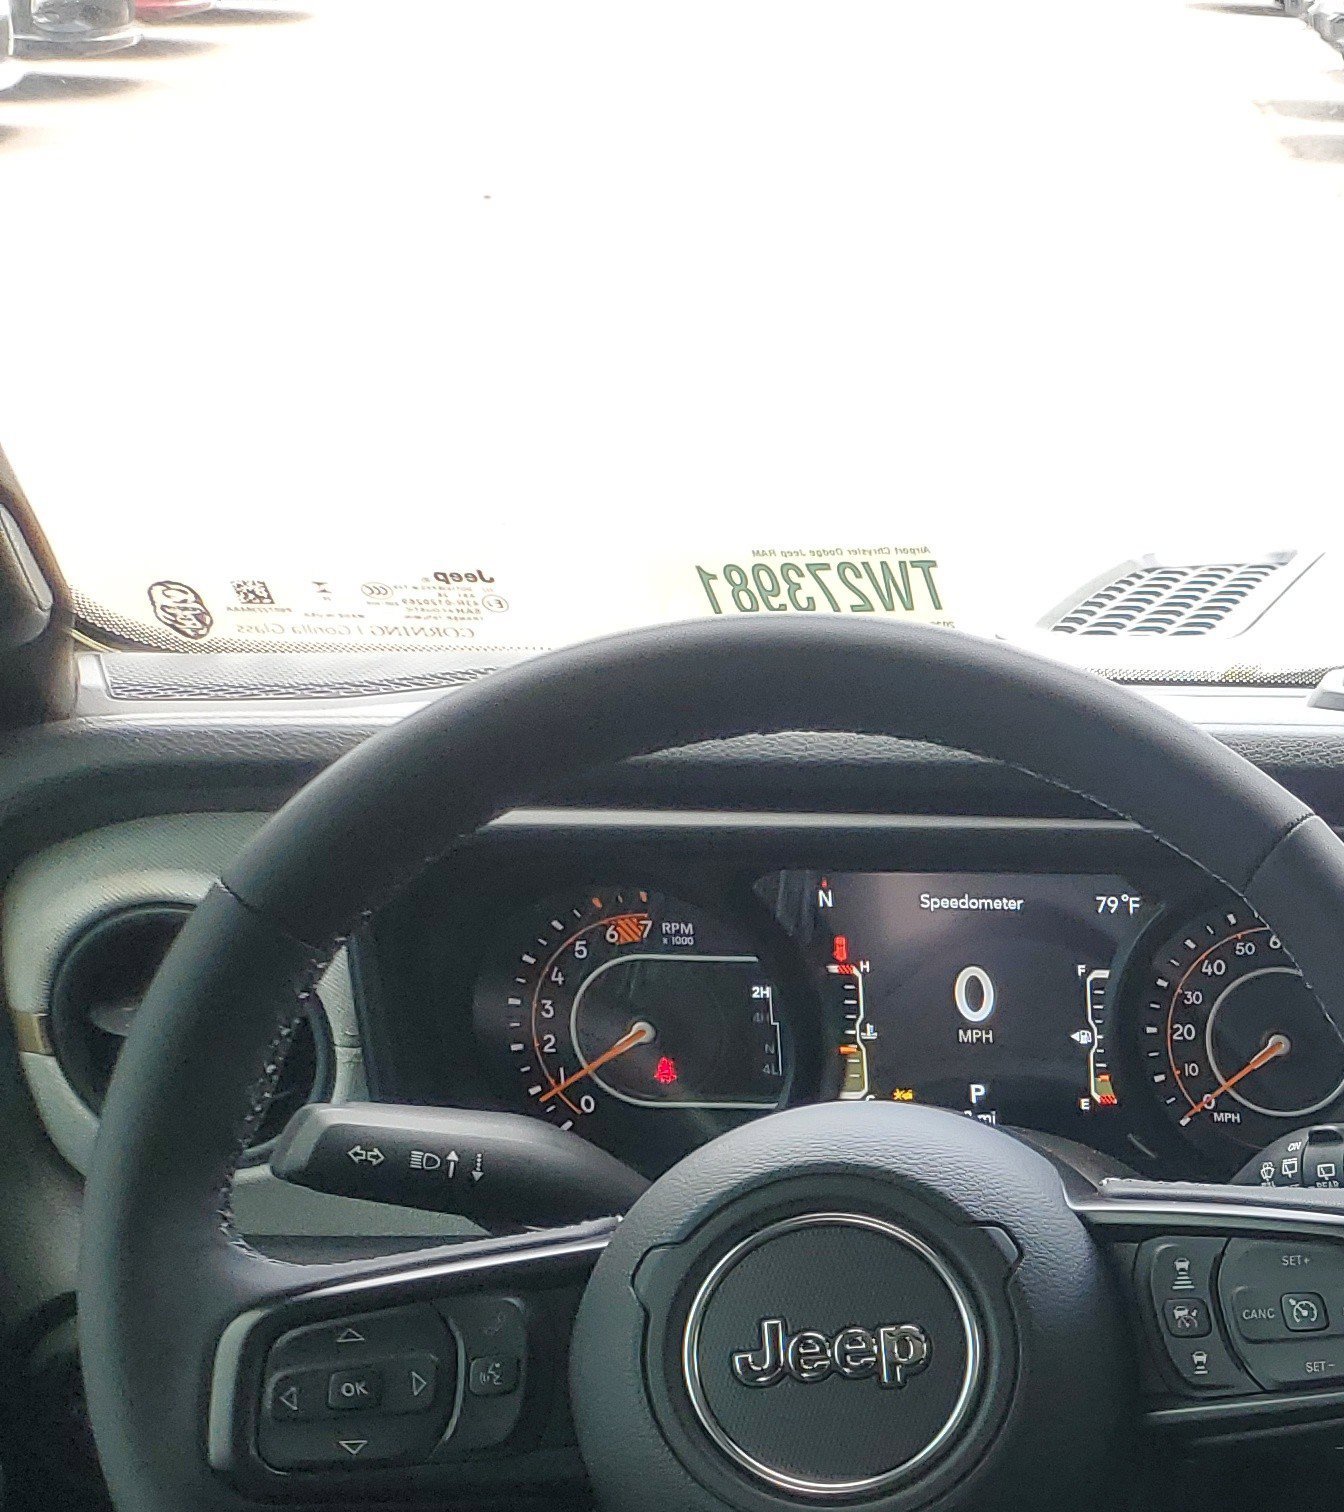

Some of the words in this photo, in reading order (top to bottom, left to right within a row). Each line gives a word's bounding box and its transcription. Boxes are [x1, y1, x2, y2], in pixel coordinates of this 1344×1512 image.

[818, 890, 833, 908] N
[919, 894, 1024, 913] Speedometer
[1095, 894, 1141, 914] 79°F
[605, 922, 619, 943] 6
[638, 919, 653, 939] 7
[661, 921, 695, 935] RPM
[573, 939, 589, 960] 5
[671, 936, 695, 946] 1000
[1234, 942, 1256, 957] 50
[550, 965, 566, 986] 4
[860, 961, 870, 973] H
[1077, 965, 1086, 977] F
[1201, 959, 1226, 977] 40
[751, 986, 770, 999] 2H
[954, 965, 995, 1022] 0
[1183, 990, 1203, 1006] 30
[540, 1000, 556, 1020] 3
[958, 1029, 994, 1045] MPH
[1173, 1024, 1196, 1042] 20
[542, 1034, 558, 1055] 2
[1185, 1063, 1199, 1077] 10
[970, 1083, 986, 1104] P
[1203, 1093, 1216, 1111] 0
[580, 1094, 597, 1114] 0
[1080, 1098, 1090, 1111] E
[1213, 1112, 1241, 1125] MPH
[1287, 1141, 1302, 1153] ON
[1241, 1307, 1276, 1320] CANC
[731, 1316, 932, 1390] Jeep
[340, 1381, 369, 1398] OK
